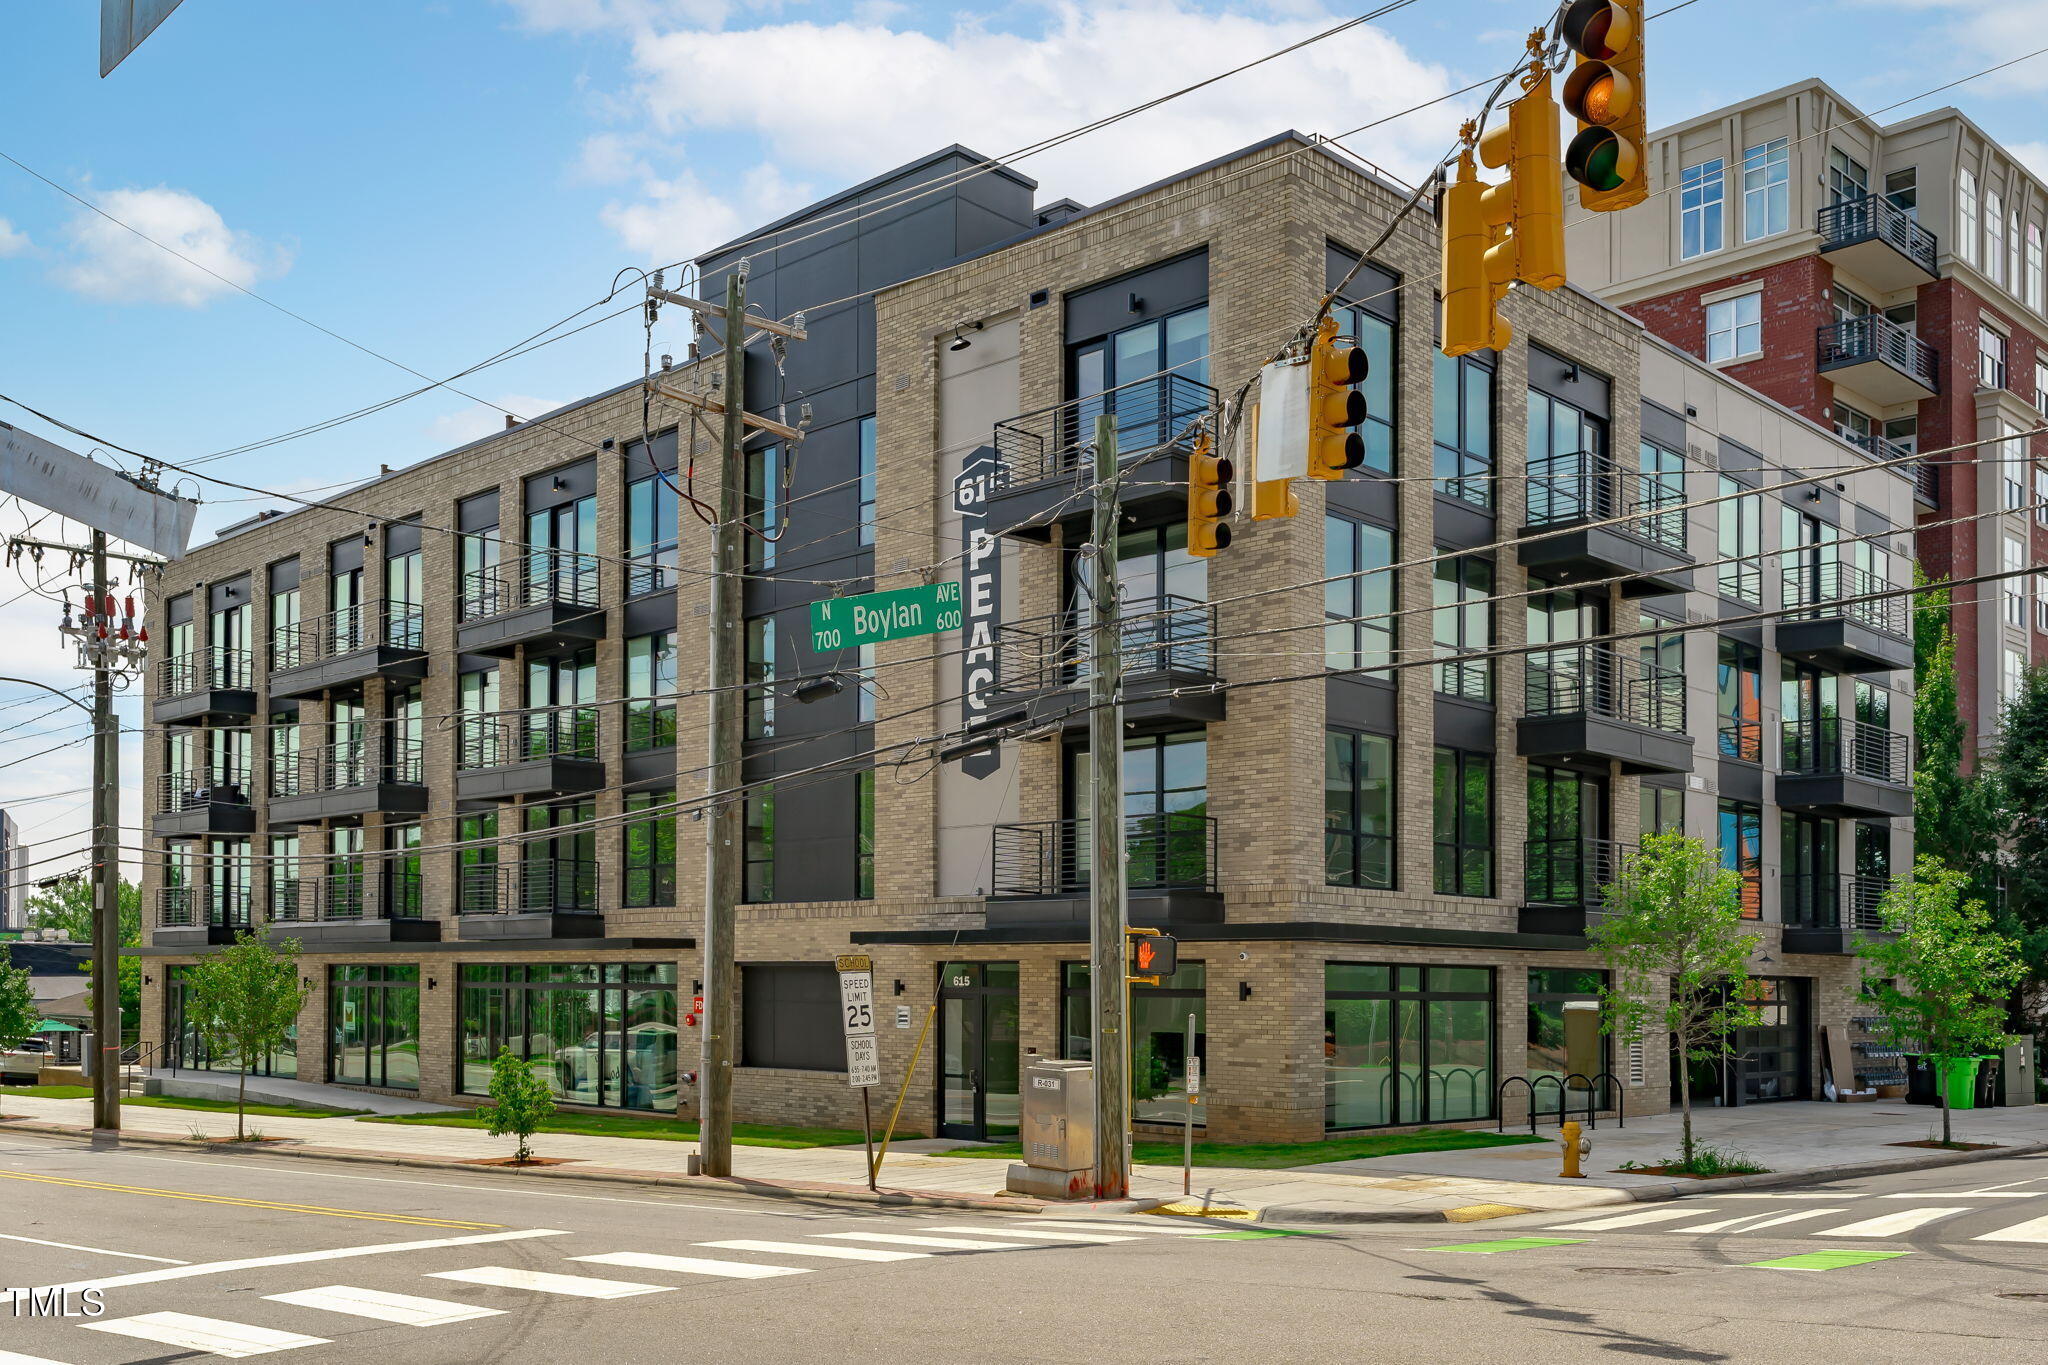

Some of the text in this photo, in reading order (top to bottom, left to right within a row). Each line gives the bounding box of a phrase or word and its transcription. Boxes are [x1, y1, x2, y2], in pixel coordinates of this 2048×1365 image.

[821, 583, 959, 639] N Boylan AVE
[936, 609, 962, 630] 600
[815, 629, 841, 650] 700
[839, 958, 869, 968] SCHOOL
[843, 979, 869, 989] SPEED
[953, 975, 970, 986] 615
[847, 991, 867, 1002] LIMIT
[847, 1005, 871, 1028] 25
[851, 1039, 873, 1049] SCHOOL
[855, 1051, 870, 1061] DAYS
